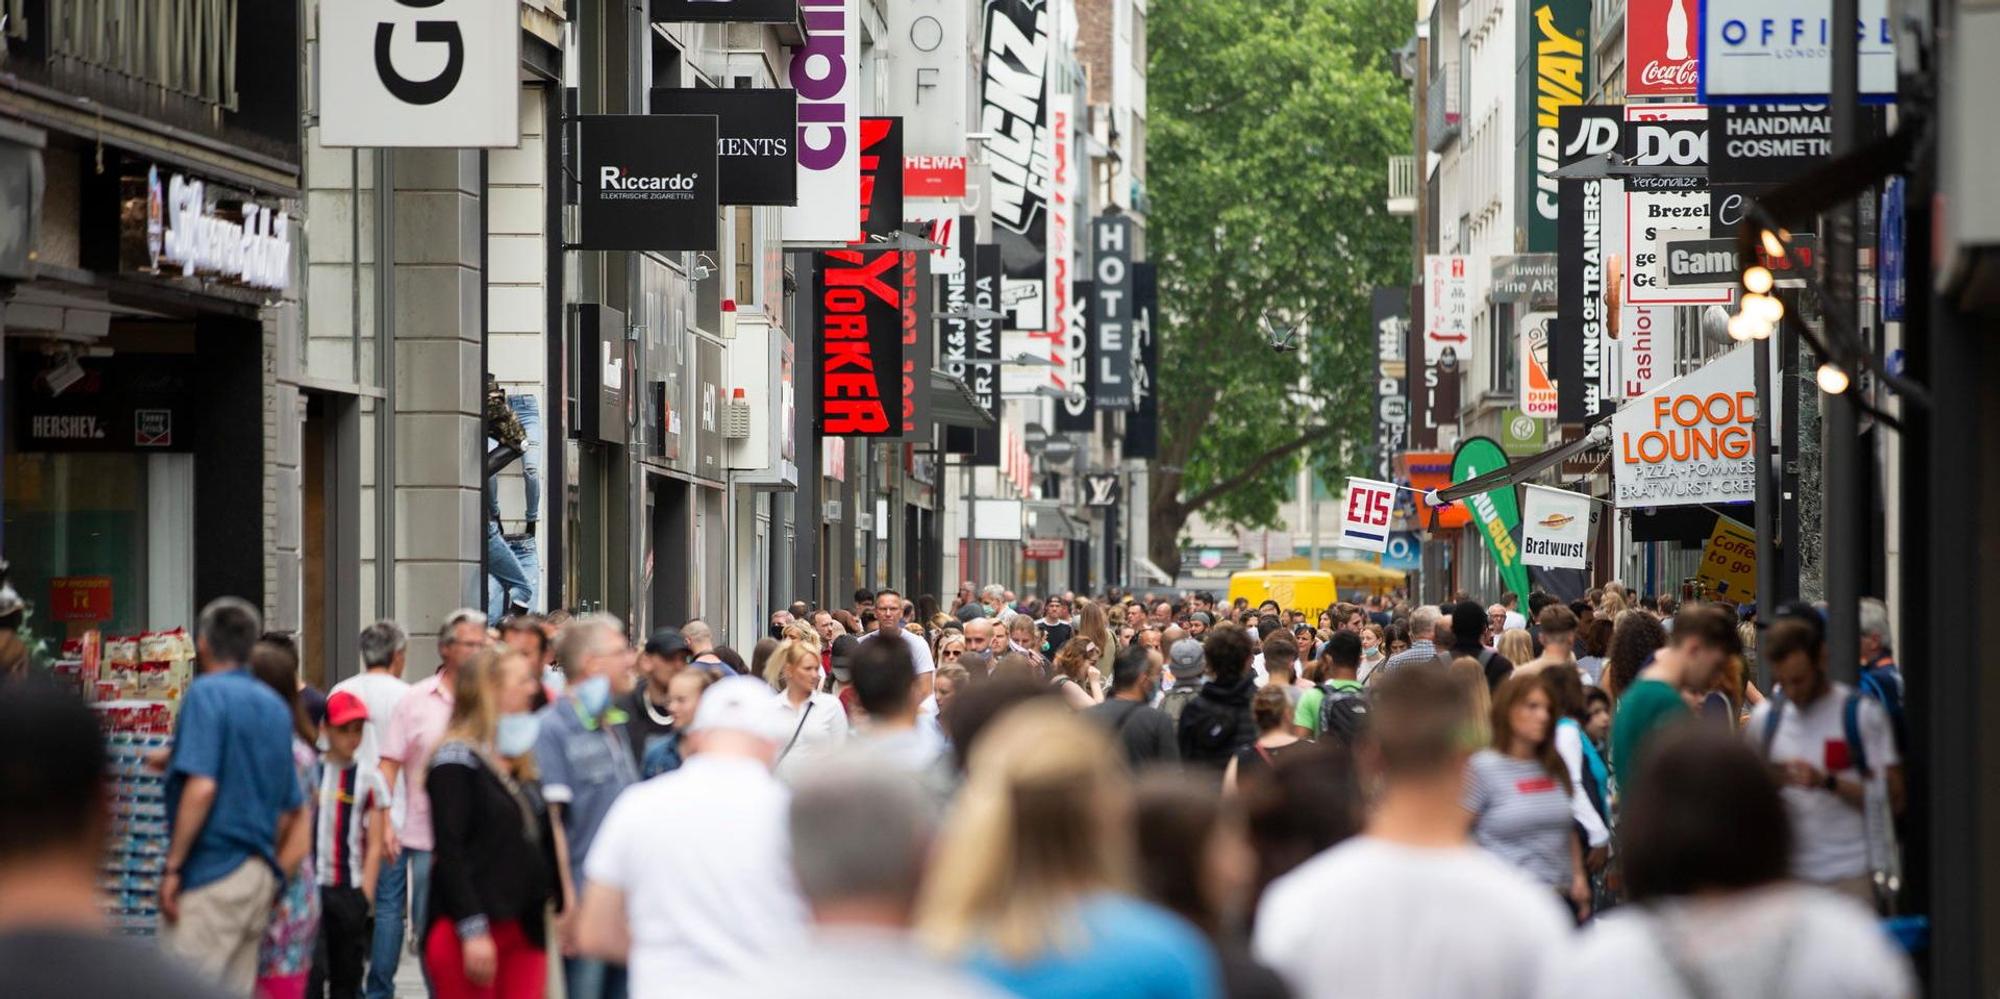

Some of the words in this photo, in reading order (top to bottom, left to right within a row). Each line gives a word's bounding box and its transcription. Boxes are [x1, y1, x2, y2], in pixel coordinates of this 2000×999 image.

[1565, 117, 1619, 156] JD
[1637, 125, 1709, 166] DO
[905, 155, 963, 170] HEMA
[600, 192, 648, 200] ELEKTRISCHE
[650, 192, 695, 200] ZIGARETTEN
[1583, 181, 1600, 292] TRAINERS
[1495, 279, 1526, 292] Fine
[1532, 279, 1558, 293] AR
[1099, 223, 1125, 385] HOTEL
[1583, 297, 1595, 319] OF
[824, 244, 900, 434] YORKER
[1583, 321, 1600, 379] KING
[1064, 296, 1087, 416] GEOX
[1623, 426, 1757, 465] LOUNG
[1634, 463, 1678, 480] PIZZA
[1689, 459, 1757, 478] POMMES
[1620, 480, 1712, 499] BRATWURST
[1348, 487, 1391, 527] EIS
[1525, 536, 1584, 558] Bratwurst
[1708, 550, 1727, 565] to
[1729, 560, 1752, 574] go
[1713, 535, 1757, 561] Coffe
